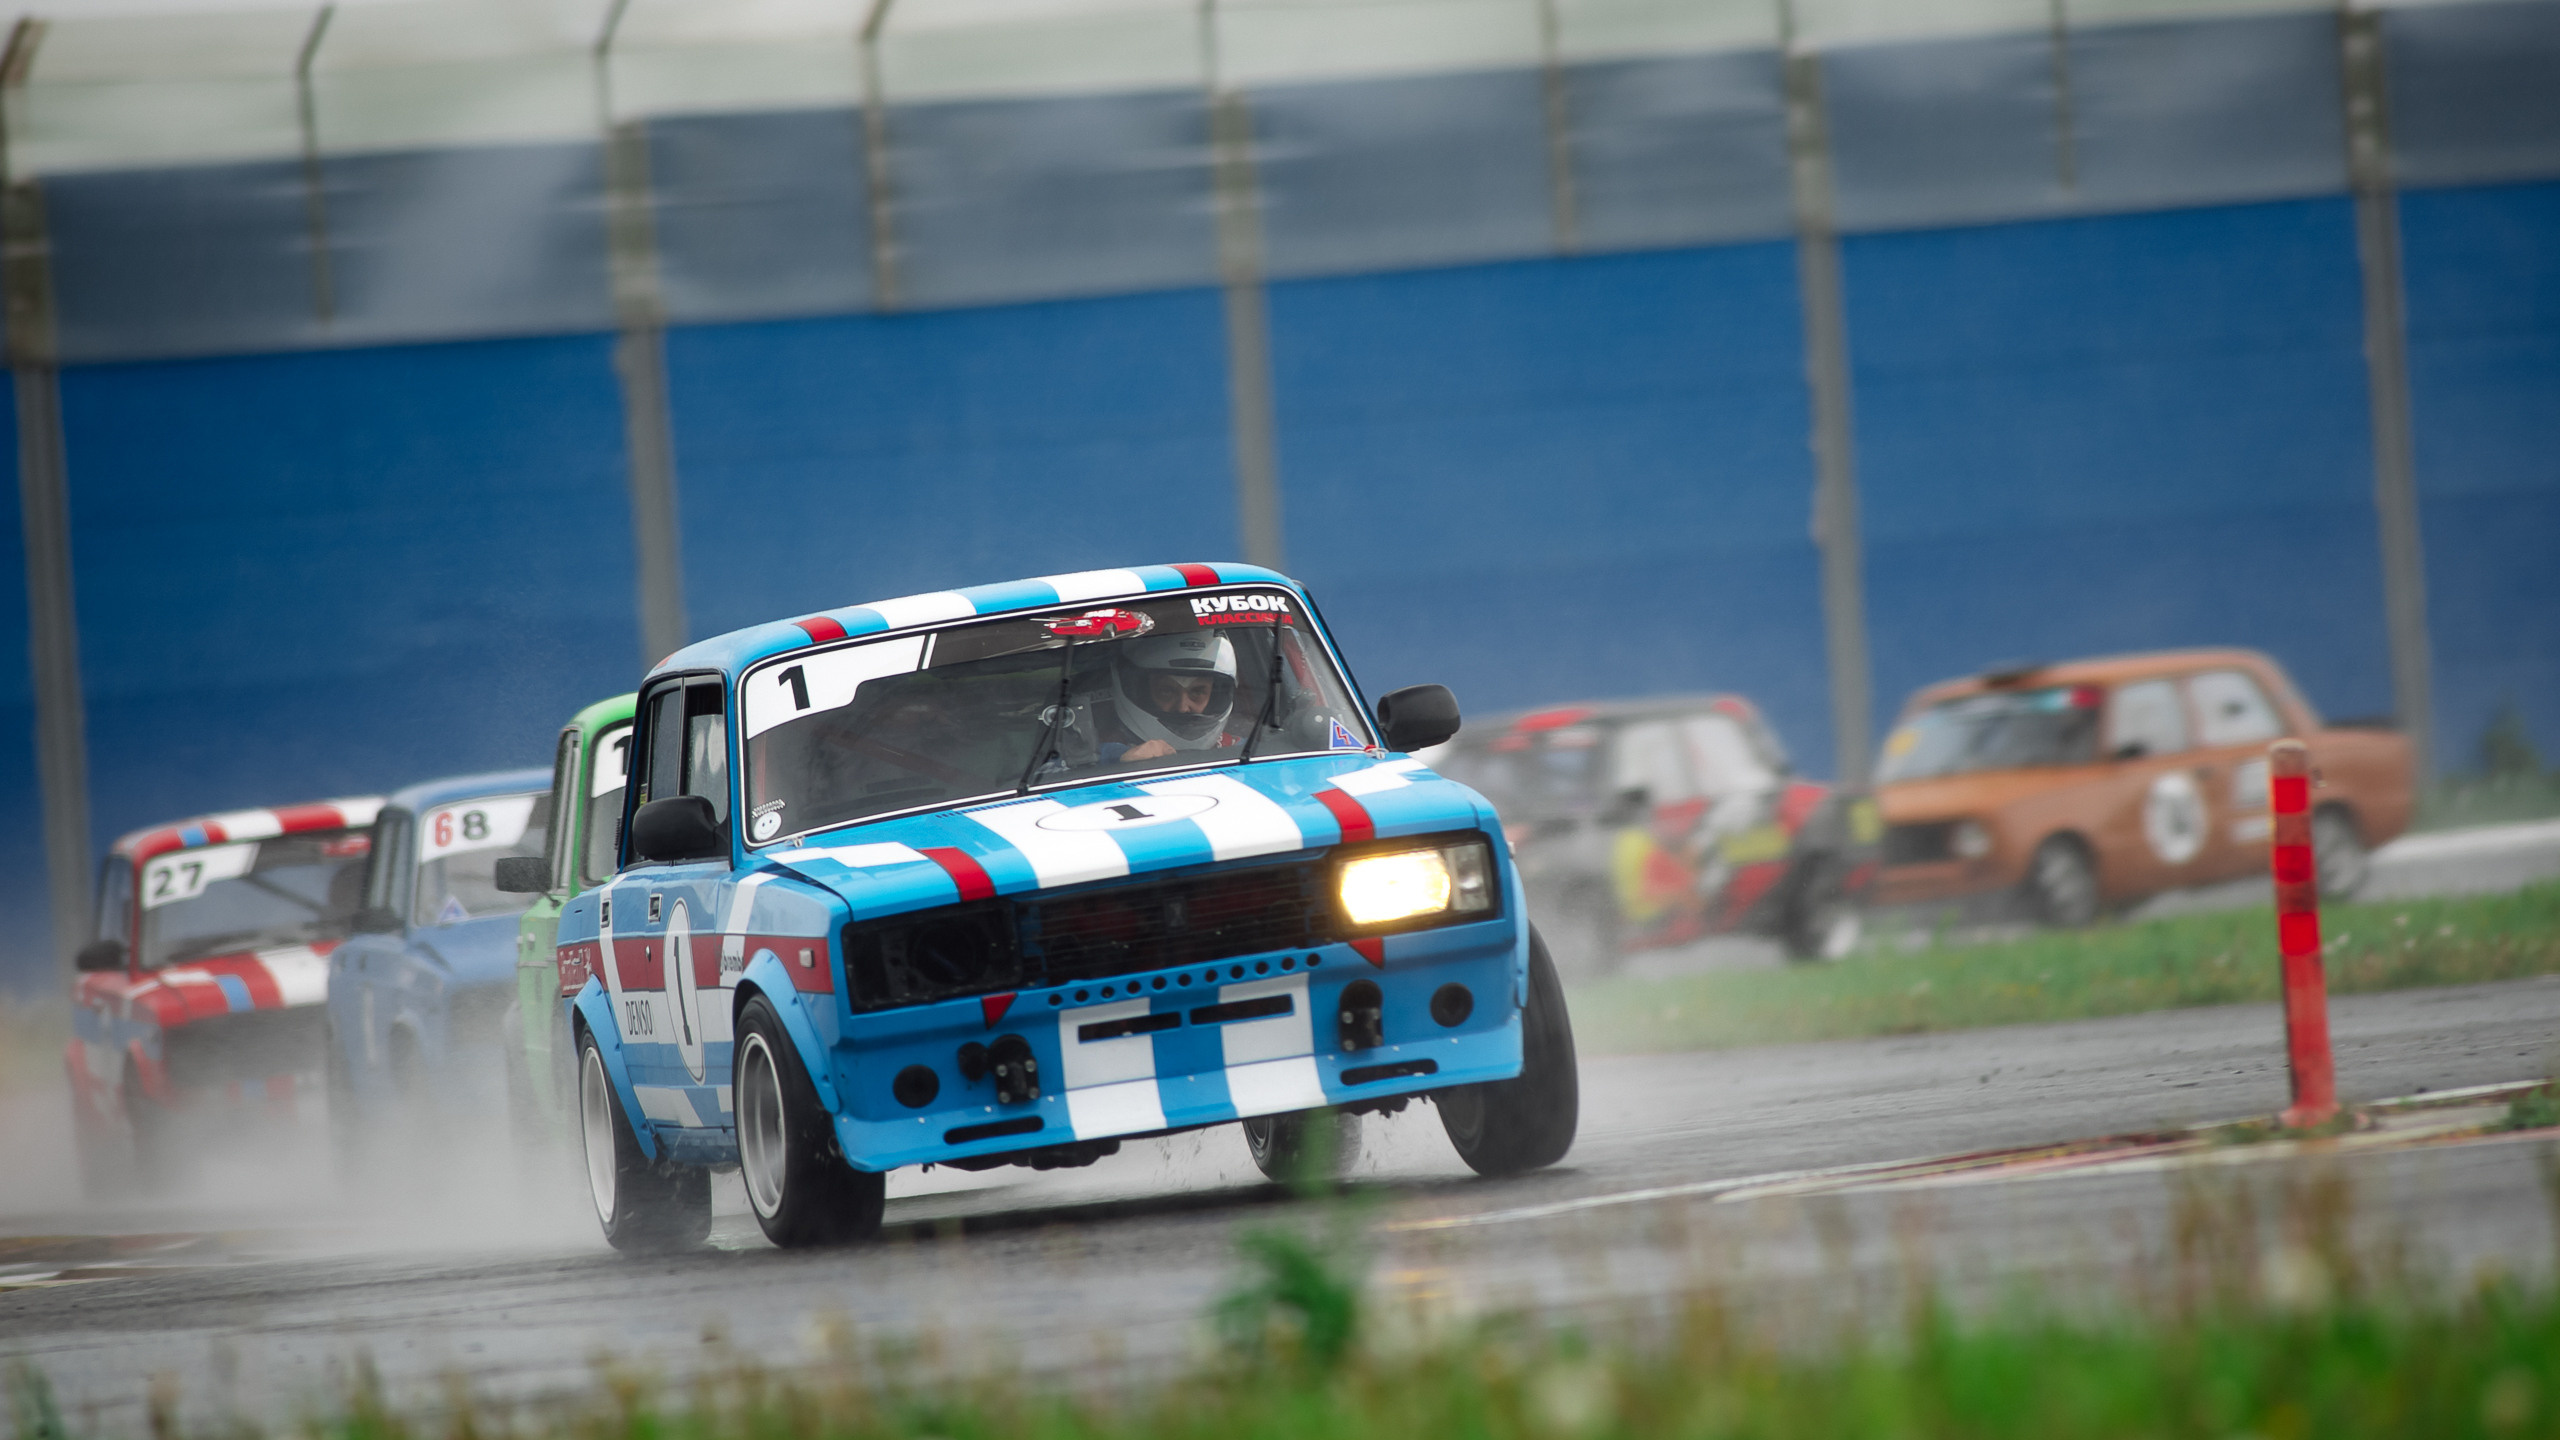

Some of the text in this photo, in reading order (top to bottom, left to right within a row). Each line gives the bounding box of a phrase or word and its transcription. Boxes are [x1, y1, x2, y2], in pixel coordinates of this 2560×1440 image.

[1190, 594, 1289, 613] КУБОК
[777, 664, 811, 711] 1
[435, 811, 489, 847] 68
[1103, 804, 1155, 821] 1
[153, 862, 203, 897] 27
[674, 936, 693, 1046] 1
[625, 1000, 653, 1036] DENSO
